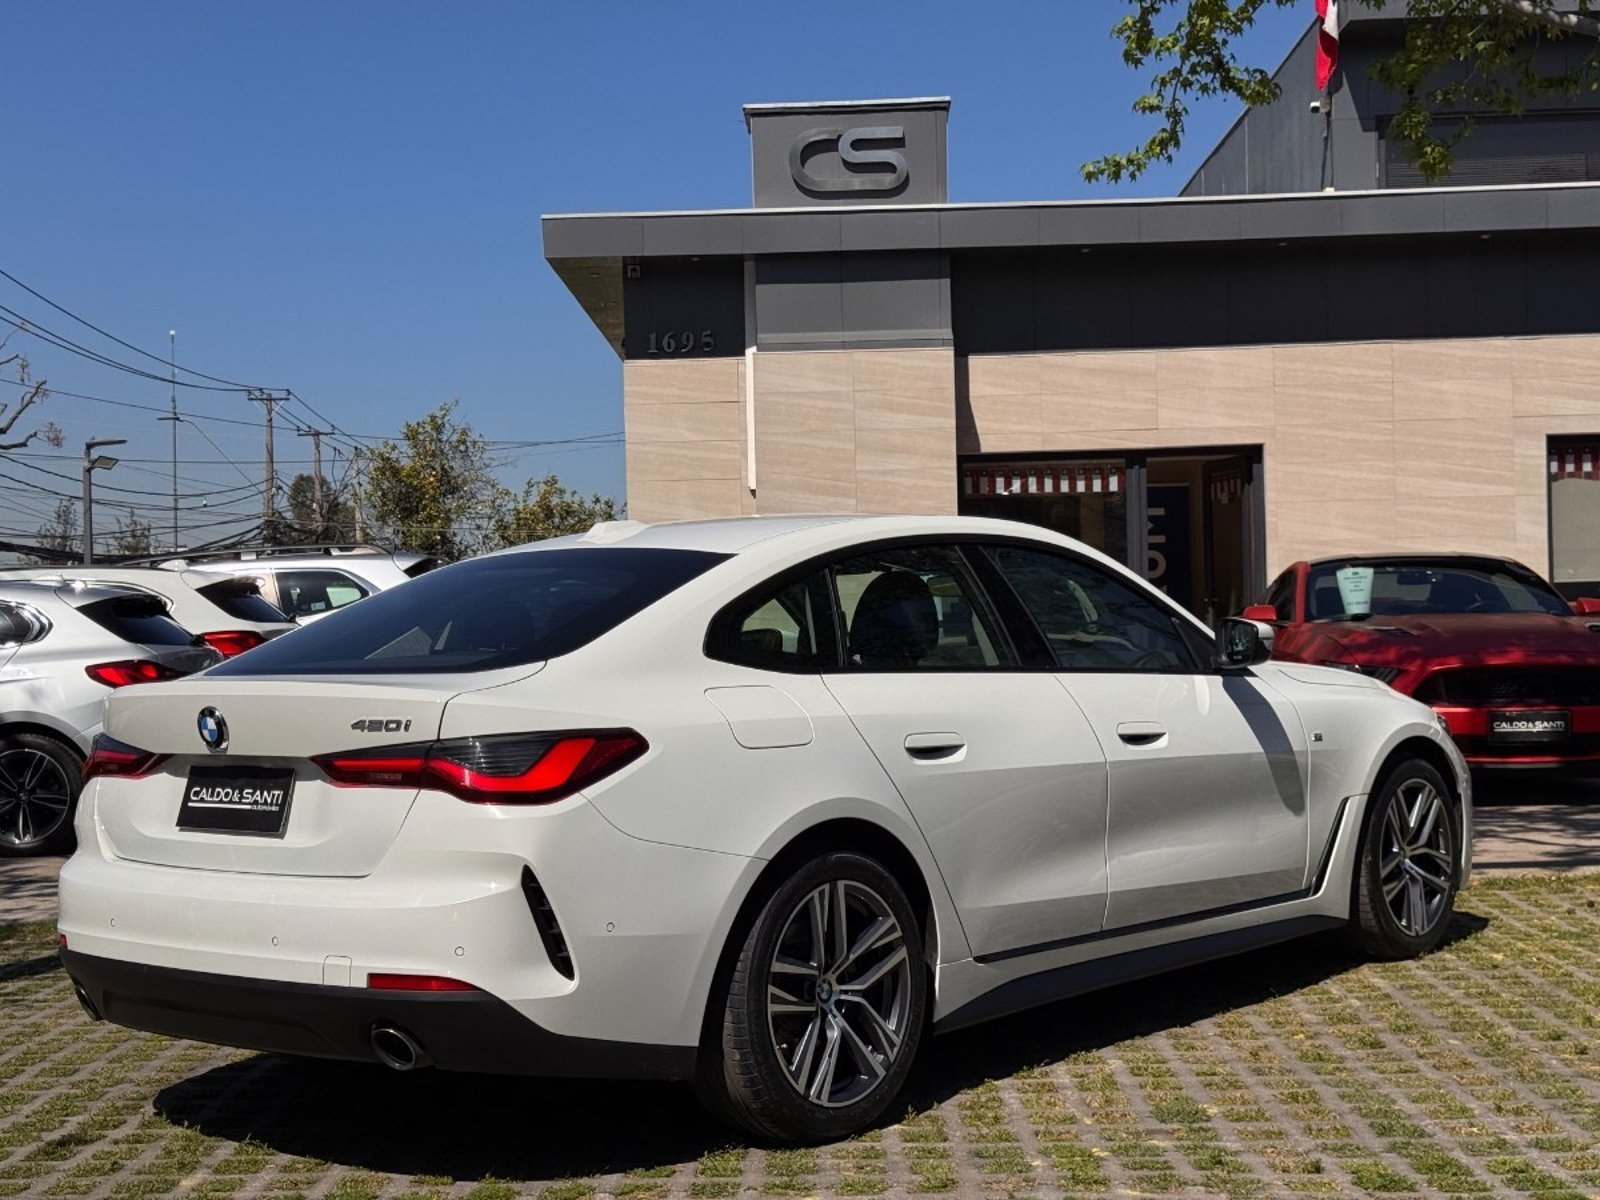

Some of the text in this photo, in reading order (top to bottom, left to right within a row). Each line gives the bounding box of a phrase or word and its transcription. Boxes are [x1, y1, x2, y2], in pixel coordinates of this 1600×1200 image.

[789, 126, 908, 193] CS
[646, 330, 714, 353] 1695
[350, 719, 412, 732] 420i
